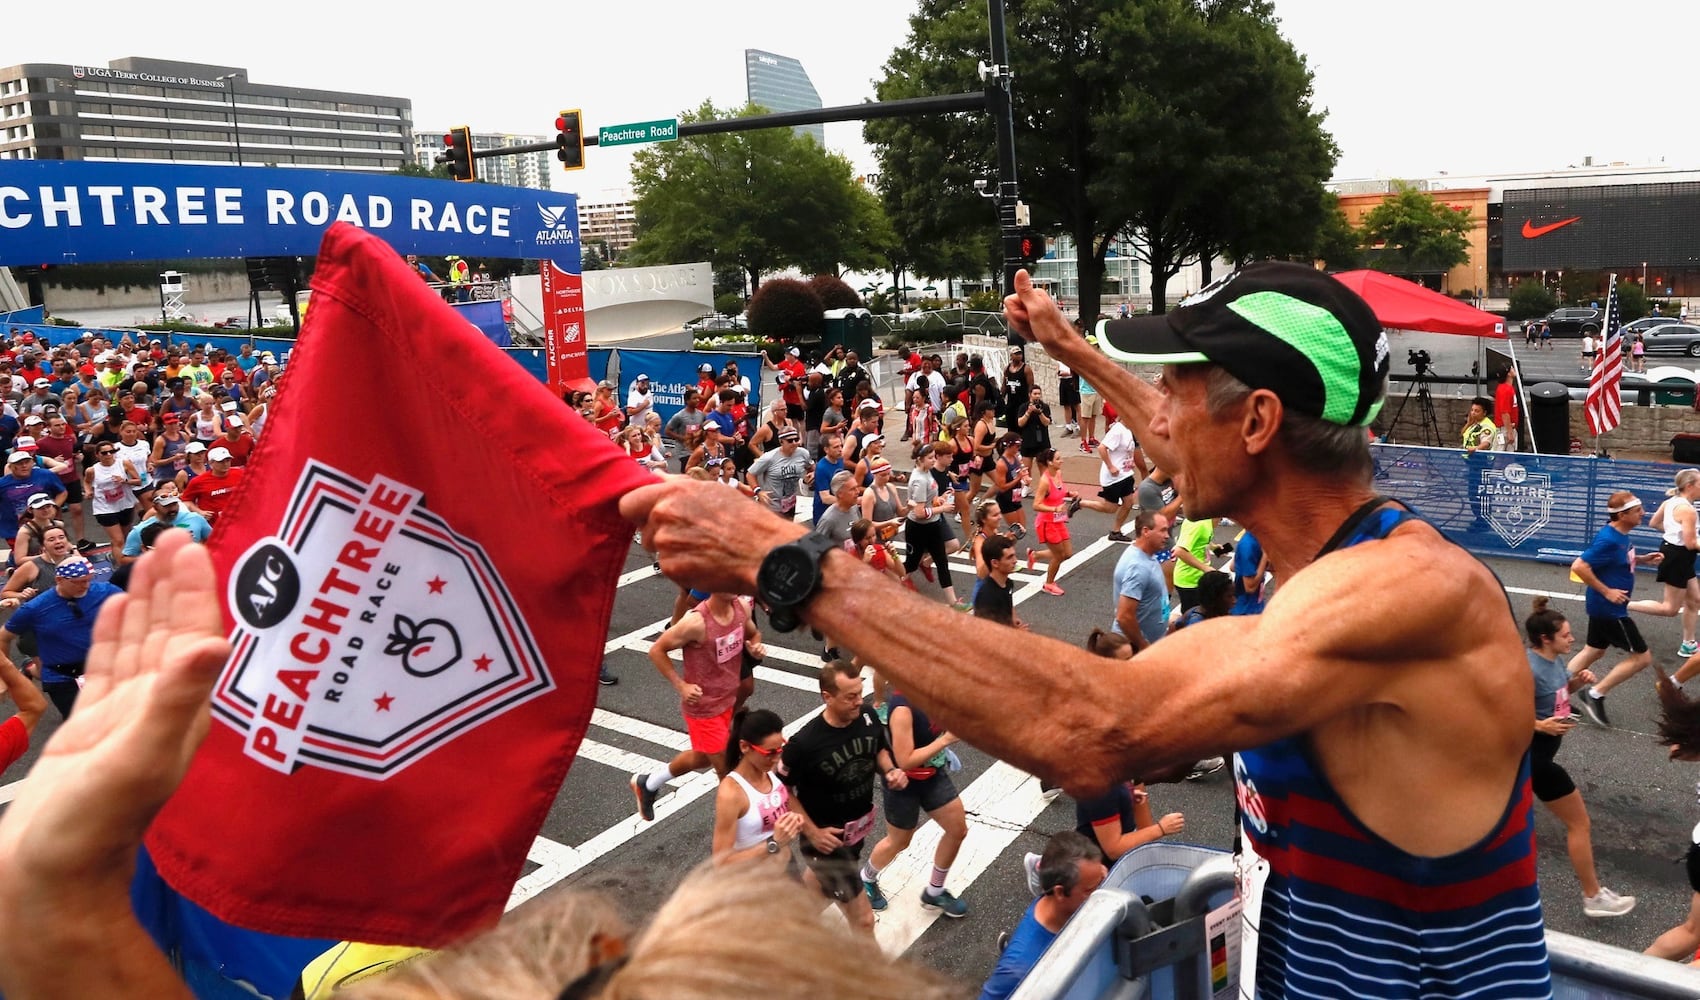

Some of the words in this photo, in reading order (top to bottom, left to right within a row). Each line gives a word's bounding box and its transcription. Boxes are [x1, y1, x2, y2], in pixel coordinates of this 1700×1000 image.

[87, 67, 112, 78] UGA
[113, 69, 139, 80] TERRY
[140, 72, 177, 84] COLLEGE
[178, 77, 189, 85] OF
[190, 77, 225, 88] BUSINESS
[602, 128, 646, 143] Peachtree
[650, 124, 673, 137] Road
[0, 185, 245, 229] CHTREE
[266, 189, 393, 228] ROAD
[410, 198, 511, 237] RACE
[536, 229, 574, 241] ATLANTA
[563, 306, 583, 314] DELTA
[547, 329, 556, 367] #AJCPRR
[649, 381, 667, 393] The
[211, 488, 227, 497] RUN
[1478, 484, 1554, 501] PEACHTREE
[249, 555, 285, 620] AJC
[252, 482, 413, 764] PEACHTREE
[324, 636, 364, 704] ROAD
[360, 562, 401, 624] RACE
[763, 815, 769, 826] E
